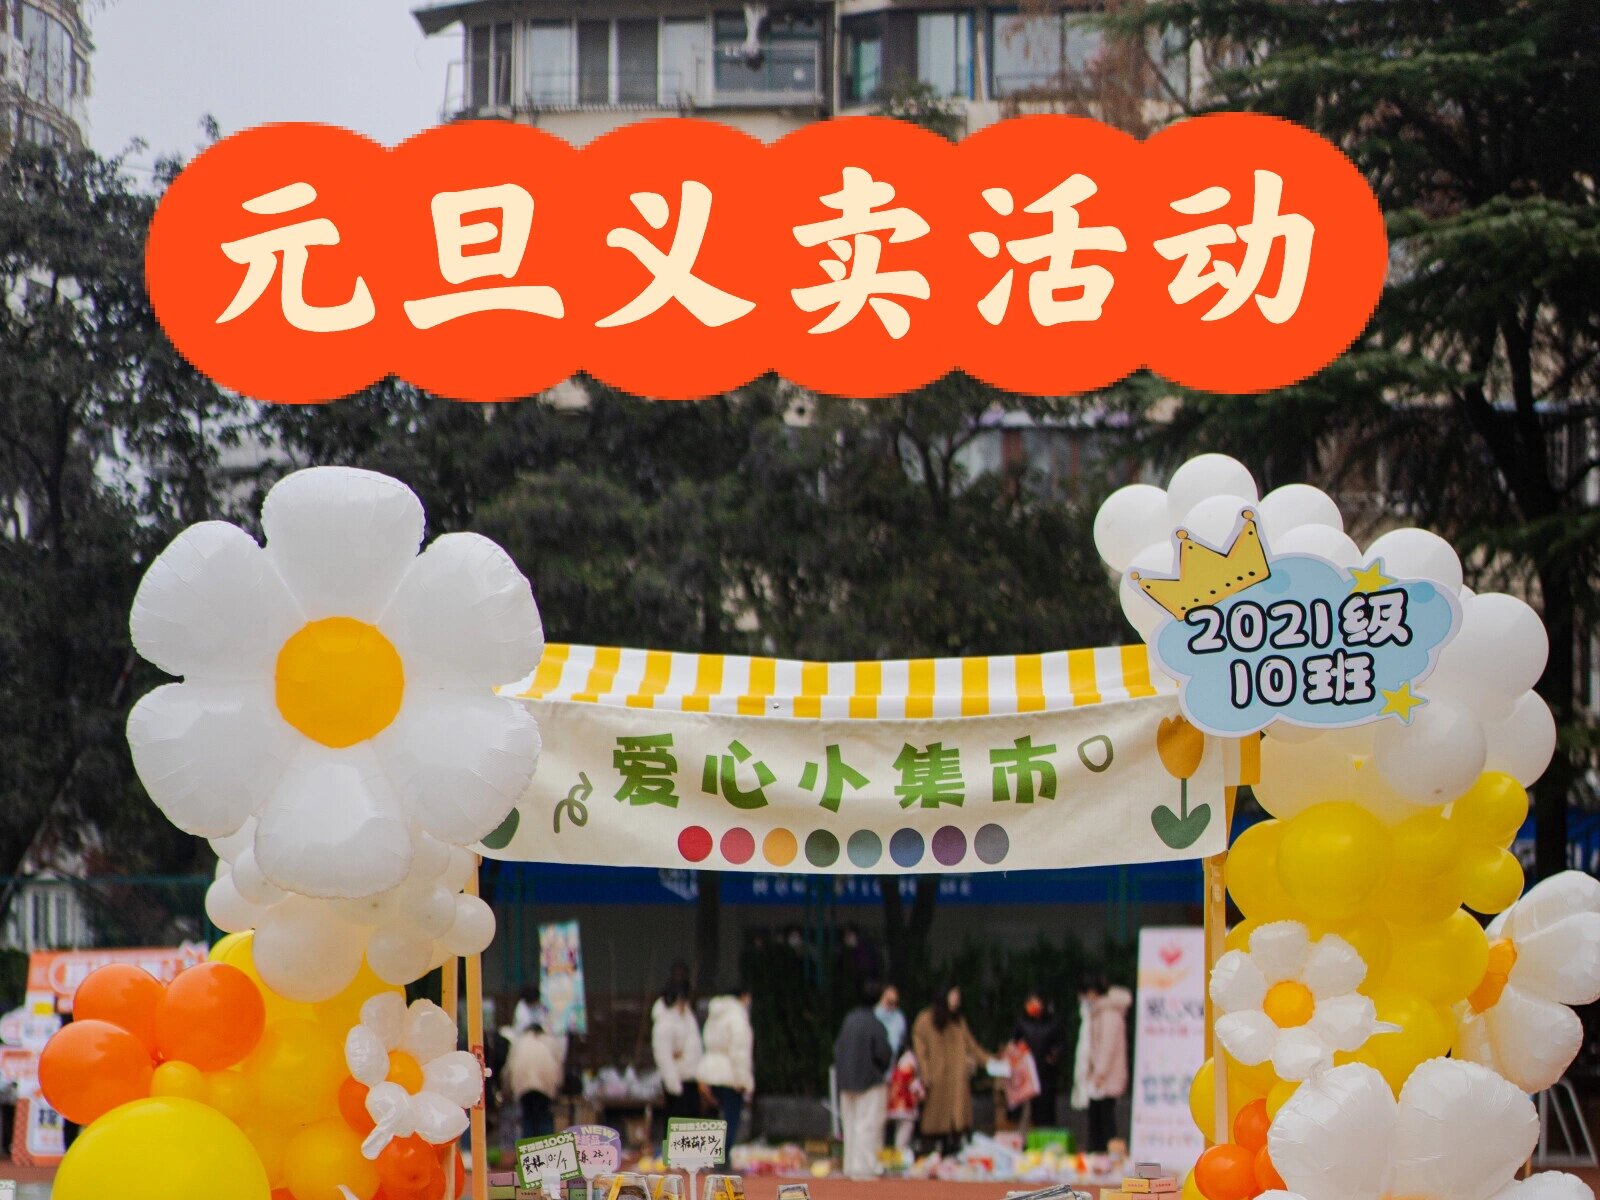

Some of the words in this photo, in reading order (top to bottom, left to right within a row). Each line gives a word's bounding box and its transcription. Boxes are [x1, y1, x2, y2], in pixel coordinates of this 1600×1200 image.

[1184, 587, 1413, 655] 2021级
[1229, 647, 1377, 709] 10班
[612, 732, 1058, 813] 爱心小集市
[581, 1126, 616, 1139] NEW
